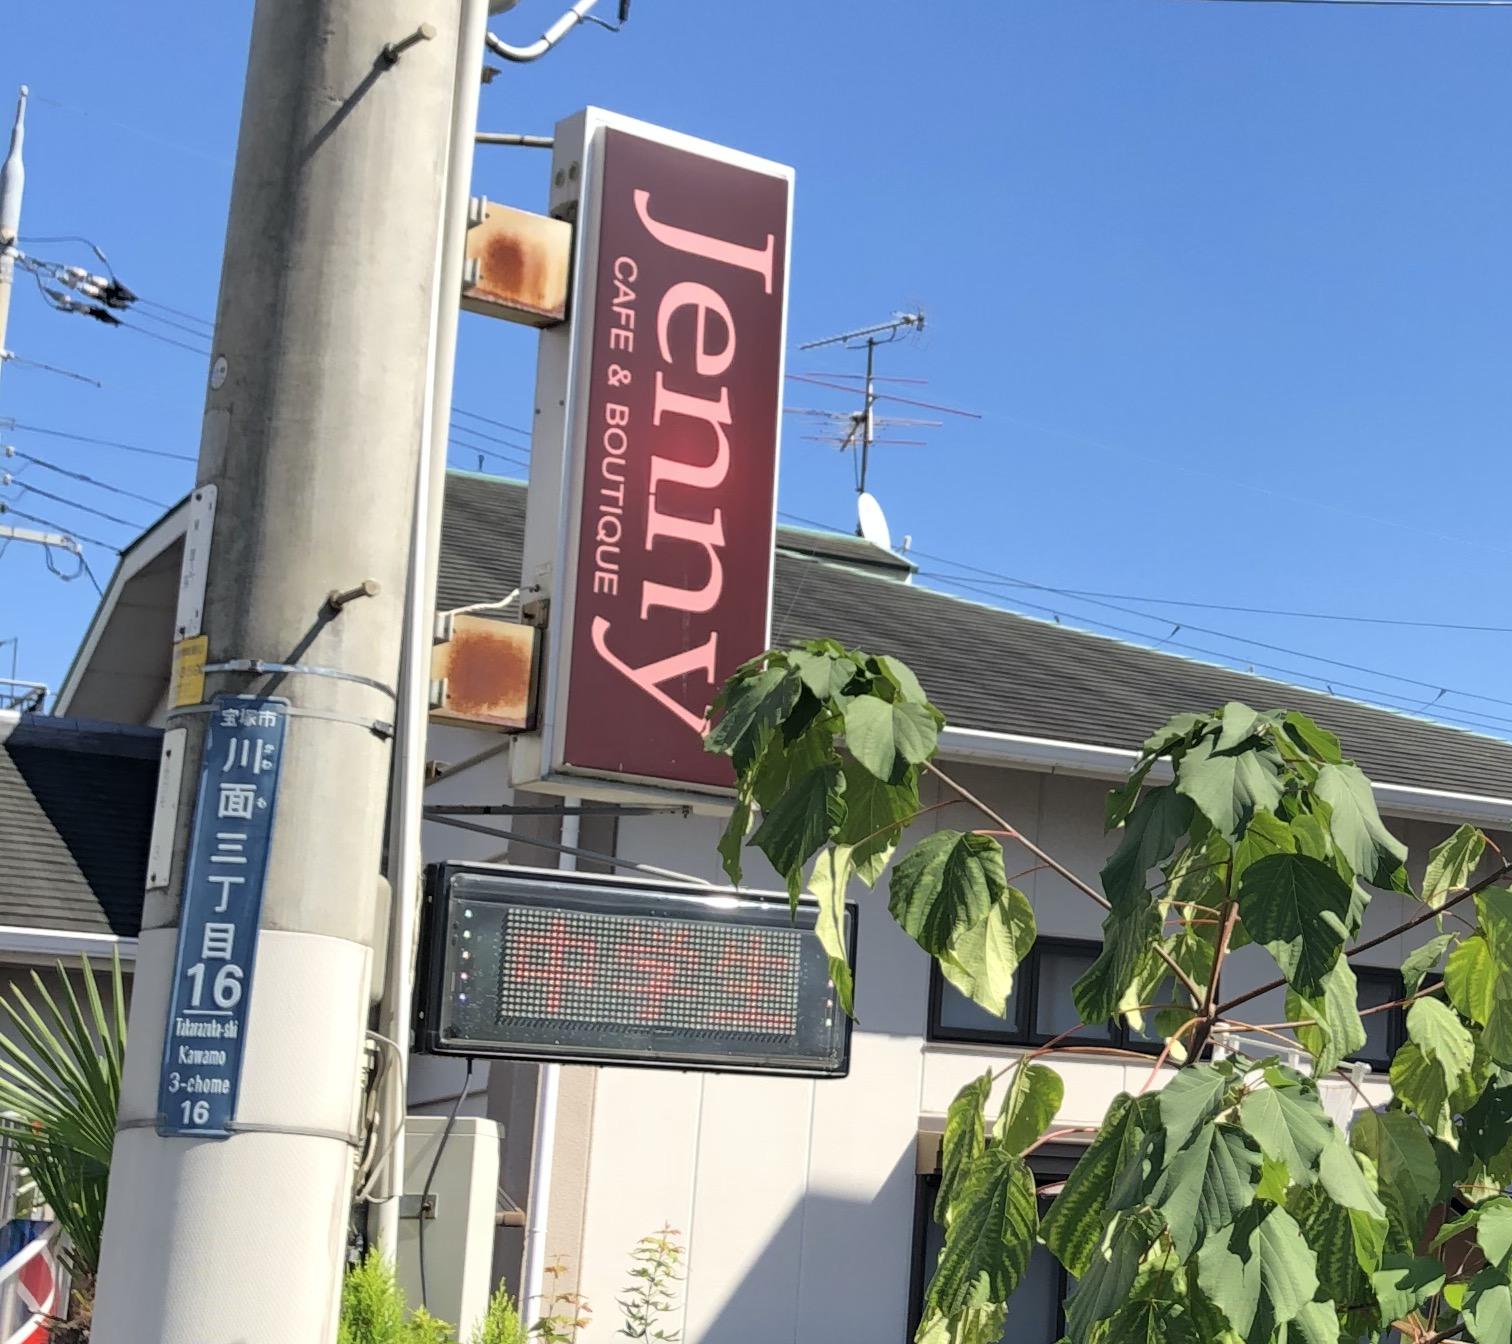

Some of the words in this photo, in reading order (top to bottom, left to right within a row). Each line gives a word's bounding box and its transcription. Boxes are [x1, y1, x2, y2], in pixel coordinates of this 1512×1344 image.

[609, 256, 638, 353] CAFE
[607, 363, 632, 387] &
[591, 189, 775, 739] Jenny
[593, 402, 630, 597] BOUTIQUE
[220, 708, 277, 728] 宝塚市
[202, 737, 263, 961] 川面三丁目
[186, 962, 244, 1009] 16
[512, 917, 794, 1027] 中学生
[175, 1017, 239, 1039] Takarazuka-shi
[178, 1044, 227, 1065] Kawamo
[168, 1072, 231, 1094] 3-chome
[180, 1100, 211, 1125] 16
